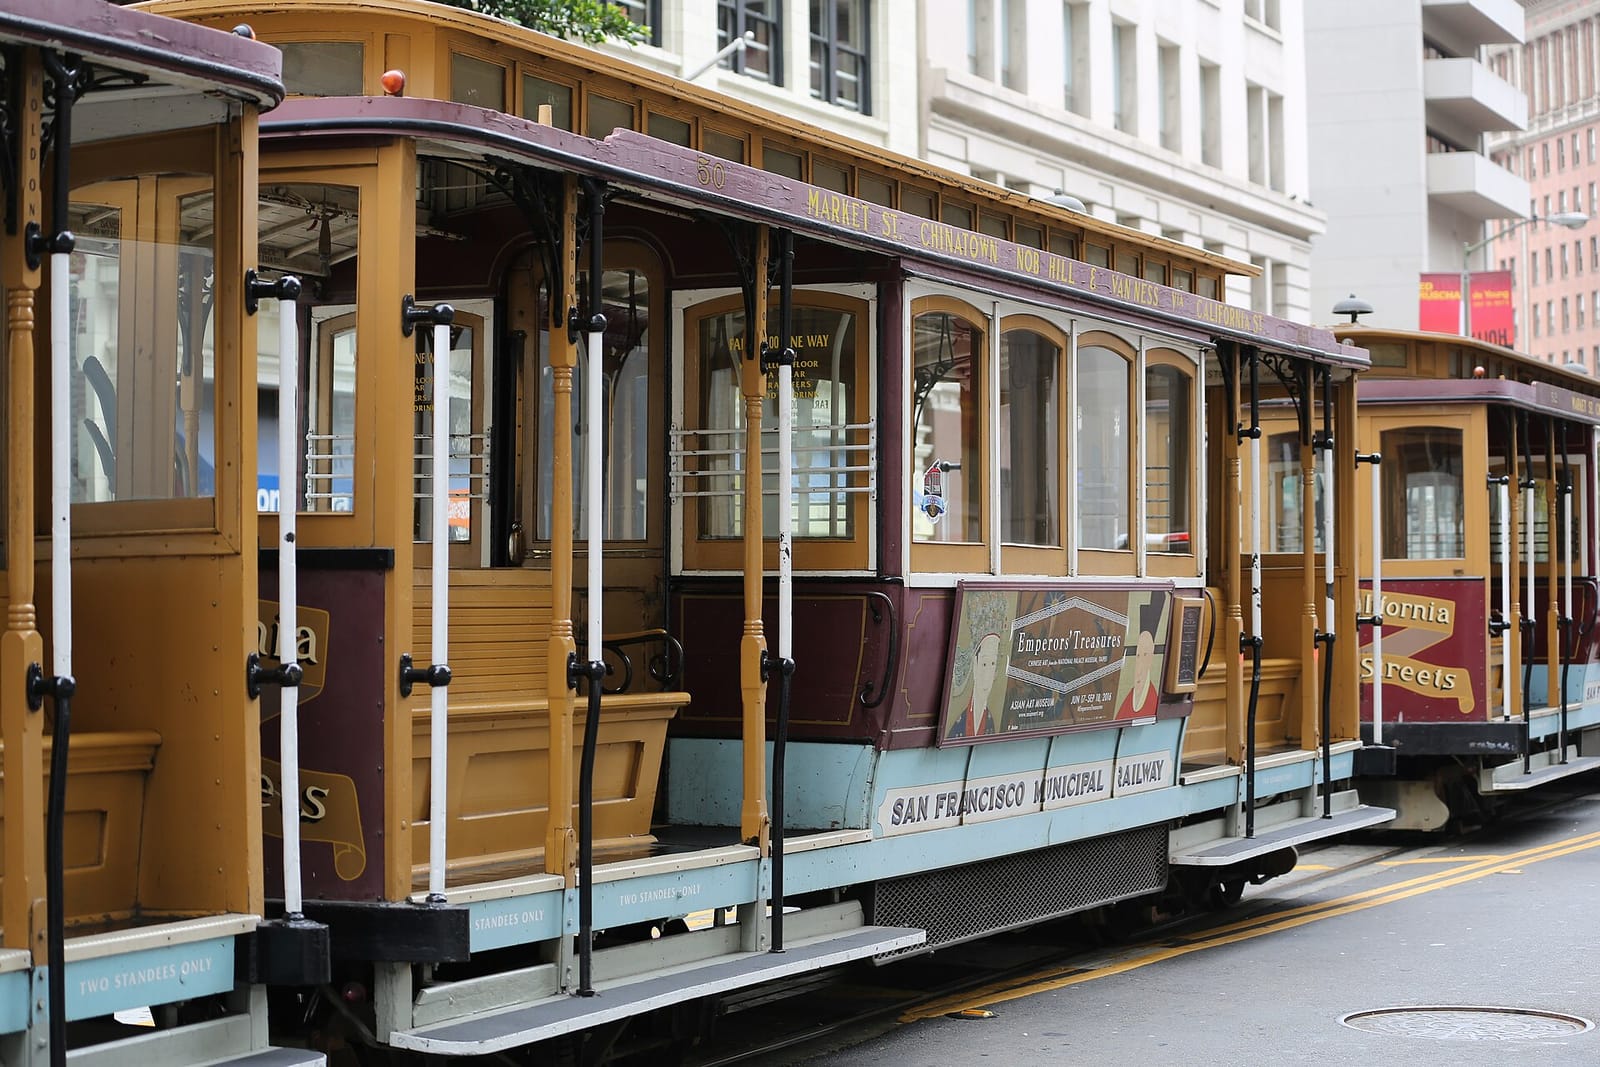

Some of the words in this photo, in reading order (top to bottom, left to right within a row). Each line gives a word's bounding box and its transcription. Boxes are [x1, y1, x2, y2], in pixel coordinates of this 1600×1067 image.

[696, 154, 727, 190] 50
[808, 188, 869, 232] MARKET
[920, 221, 999, 264] CHINATOWN
[1016, 246, 1040, 275] NOB
[1048, 255, 1075, 285] HILL
[1111, 274, 1132, 300] VAN
[1133, 281, 1160, 307] NESS
[1196, 299, 1251, 332] CALIFORNIA
[807, 334, 829, 348] WAY
[1017, 630, 1072, 655] Emperors'
[1073, 630, 1121, 650] Treasures
[1360, 658, 1457, 689] Sreets
[891, 795, 928, 826] SAN
[934, 780, 1025, 819] FRANCISCO
[1033, 769, 1104, 804] MUNICIPAL
[620, 895, 637, 906] TWO
[639, 887, 676, 904] STANDEES
[681, 883, 702, 898] ONLY
[475, 912, 519, 931] STANDEES
[521, 907, 544, 922] ONLY
[79, 977, 109, 996] TWO
[114, 963, 177, 989] STANDEES
[180, 957, 212, 976] ONLY
